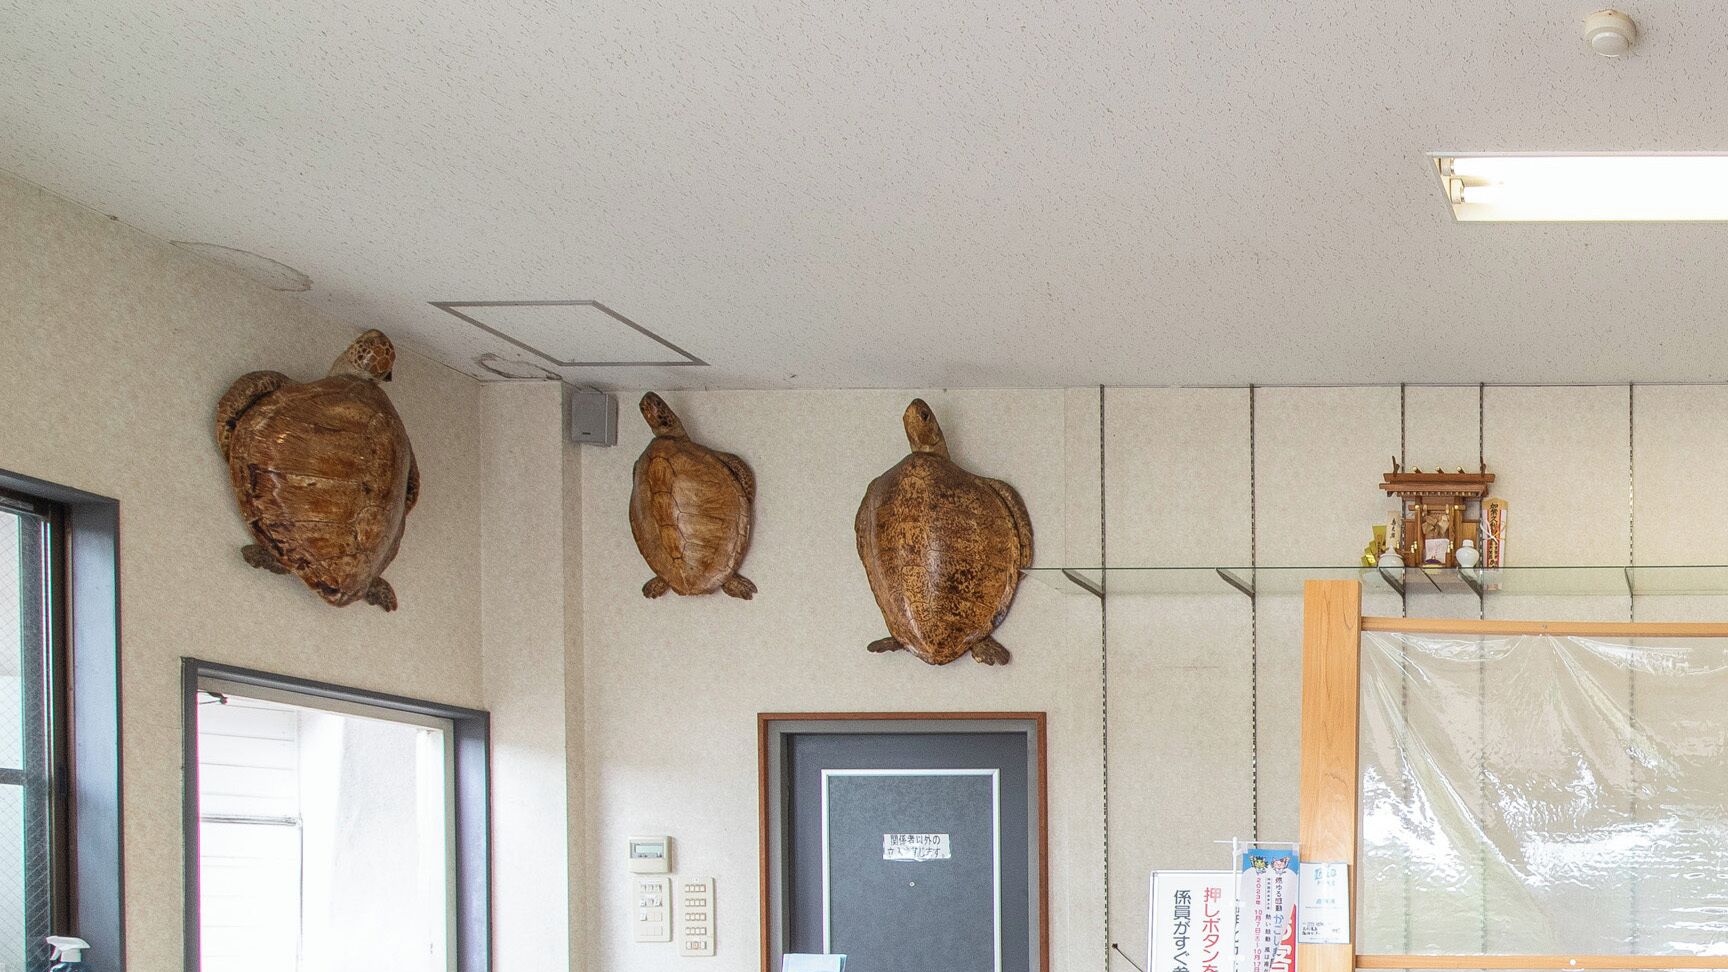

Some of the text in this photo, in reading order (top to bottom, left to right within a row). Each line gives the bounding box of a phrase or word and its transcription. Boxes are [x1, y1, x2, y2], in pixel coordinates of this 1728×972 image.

[890, 834, 941, 846] 関係者以外の
